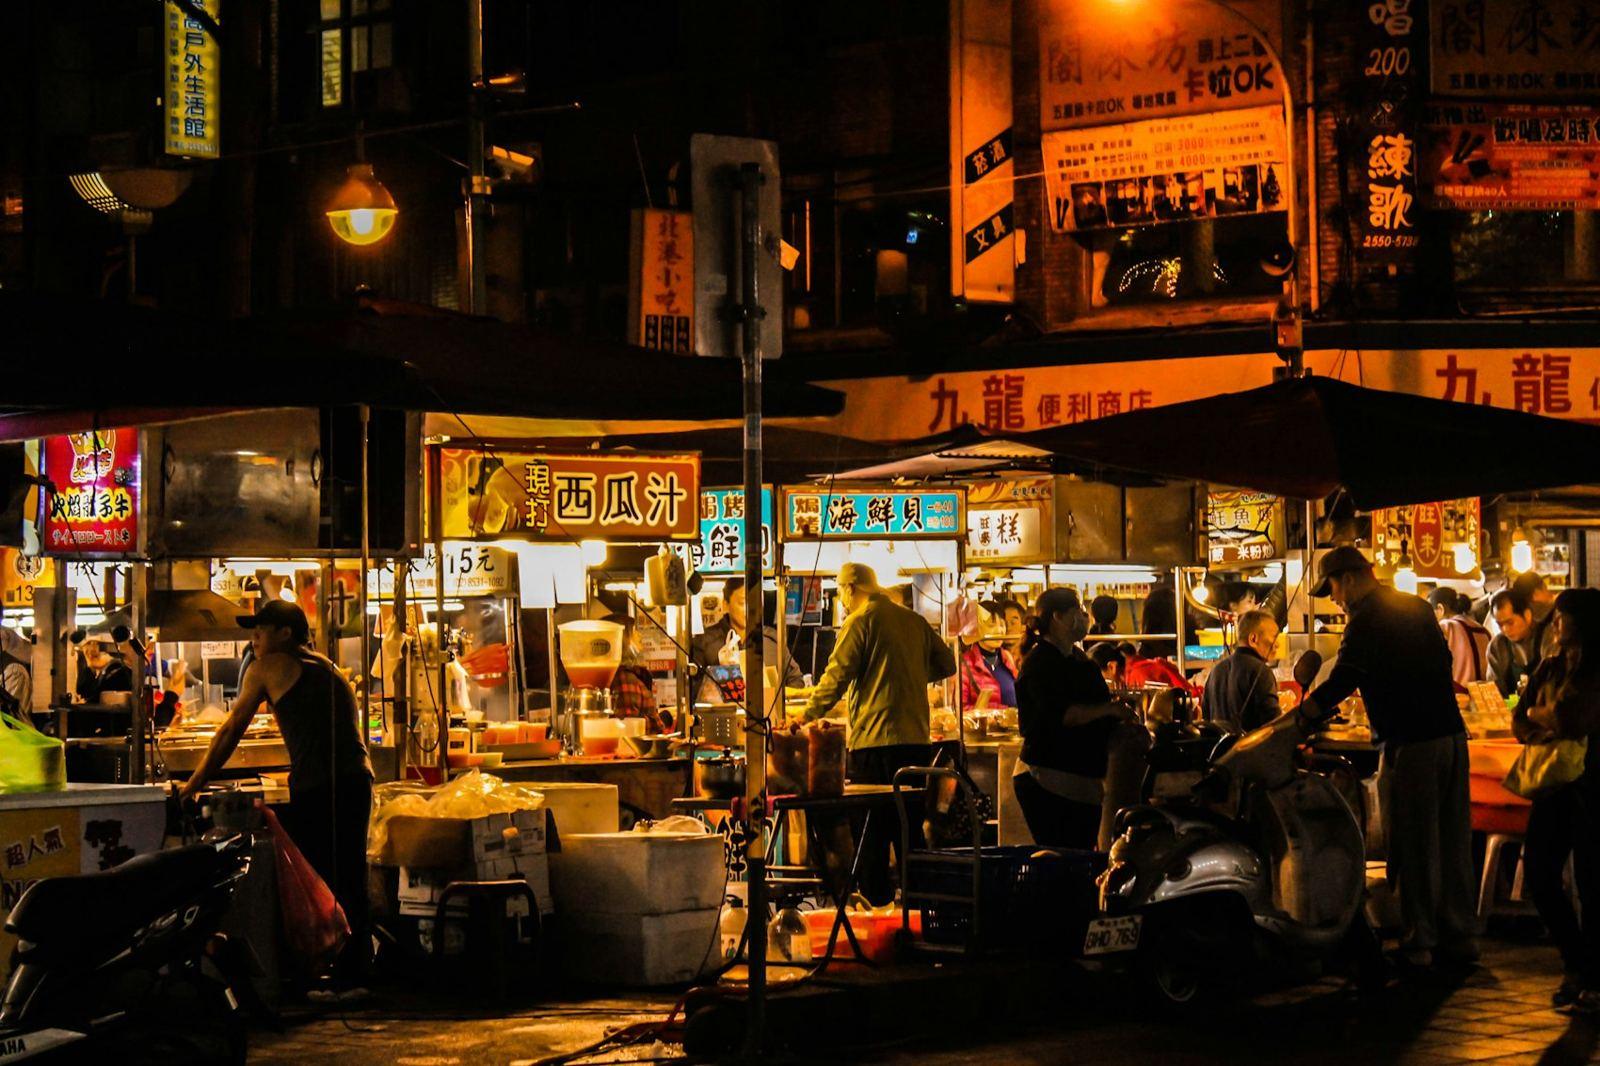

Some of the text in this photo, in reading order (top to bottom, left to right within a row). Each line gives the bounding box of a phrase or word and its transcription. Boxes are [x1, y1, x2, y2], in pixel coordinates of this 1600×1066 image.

[1184, 60, 1276, 103] 卡拉OK
[1364, 47, 1411, 79] 200
[1494, 115, 1600, 143] 歡唱及時
[1368, 133, 1414, 231] 練歌
[929, 374, 1152, 433] 九龍 便利商店
[1435, 353, 1573, 414] 九龍
[525, 462, 550, 528] 現打
[555, 474, 685, 526] 西瓜汁
[829, 496, 924, 533] 海鮮貝
[996, 512, 1022, 545] 糕
